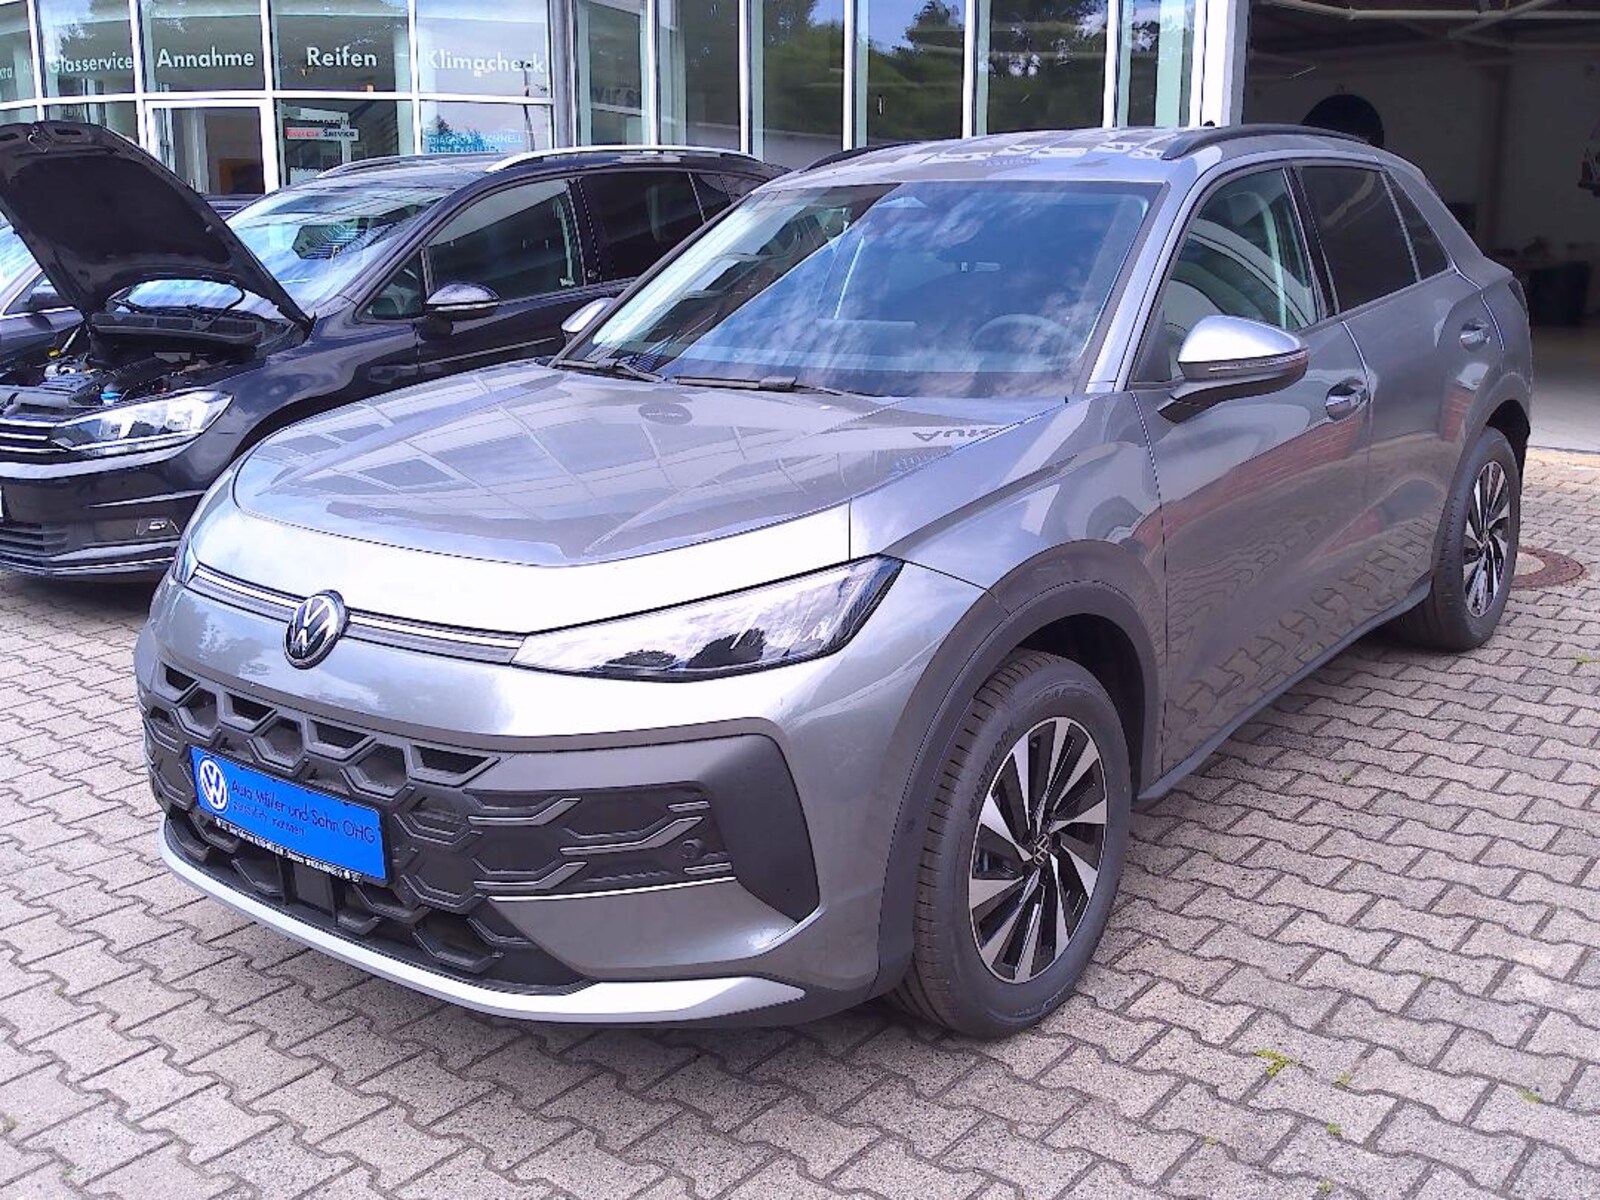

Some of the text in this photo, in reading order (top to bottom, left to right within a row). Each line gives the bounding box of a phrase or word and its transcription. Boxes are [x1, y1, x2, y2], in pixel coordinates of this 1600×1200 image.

[48, 51, 133, 74] Glasservice
[157, 46, 255, 69] Annahme
[306, 46, 377, 68] Reifen
[425, 48, 544, 73] Klimacheck
[342, 820, 376, 844] OHG
